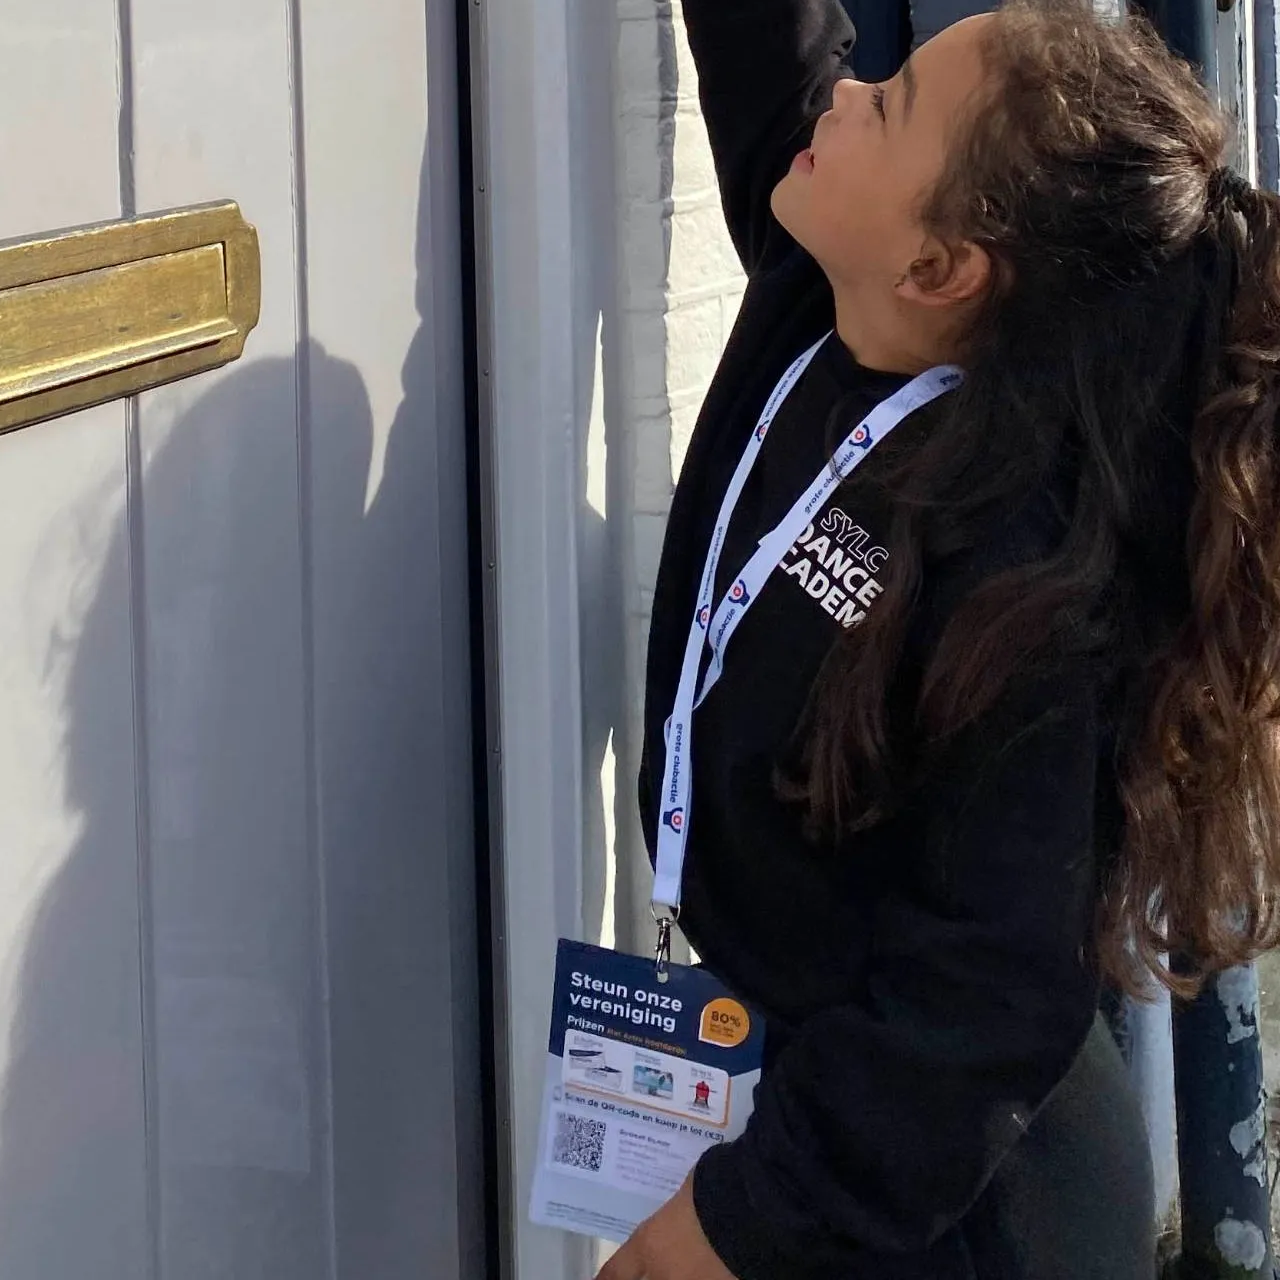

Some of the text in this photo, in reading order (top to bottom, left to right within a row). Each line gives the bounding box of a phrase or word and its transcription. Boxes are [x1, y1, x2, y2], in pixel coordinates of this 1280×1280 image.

[804, 488, 824, 515] grote
[820, 507, 890, 574] SYLC
[669, 723, 684, 804] grote clubactie
[570, 970, 683, 1013] Steun onze
[566, 1014, 605, 1033] Prijzen
[569, 992, 676, 1033] vereniging
[587, 1098, 599, 1109] de
